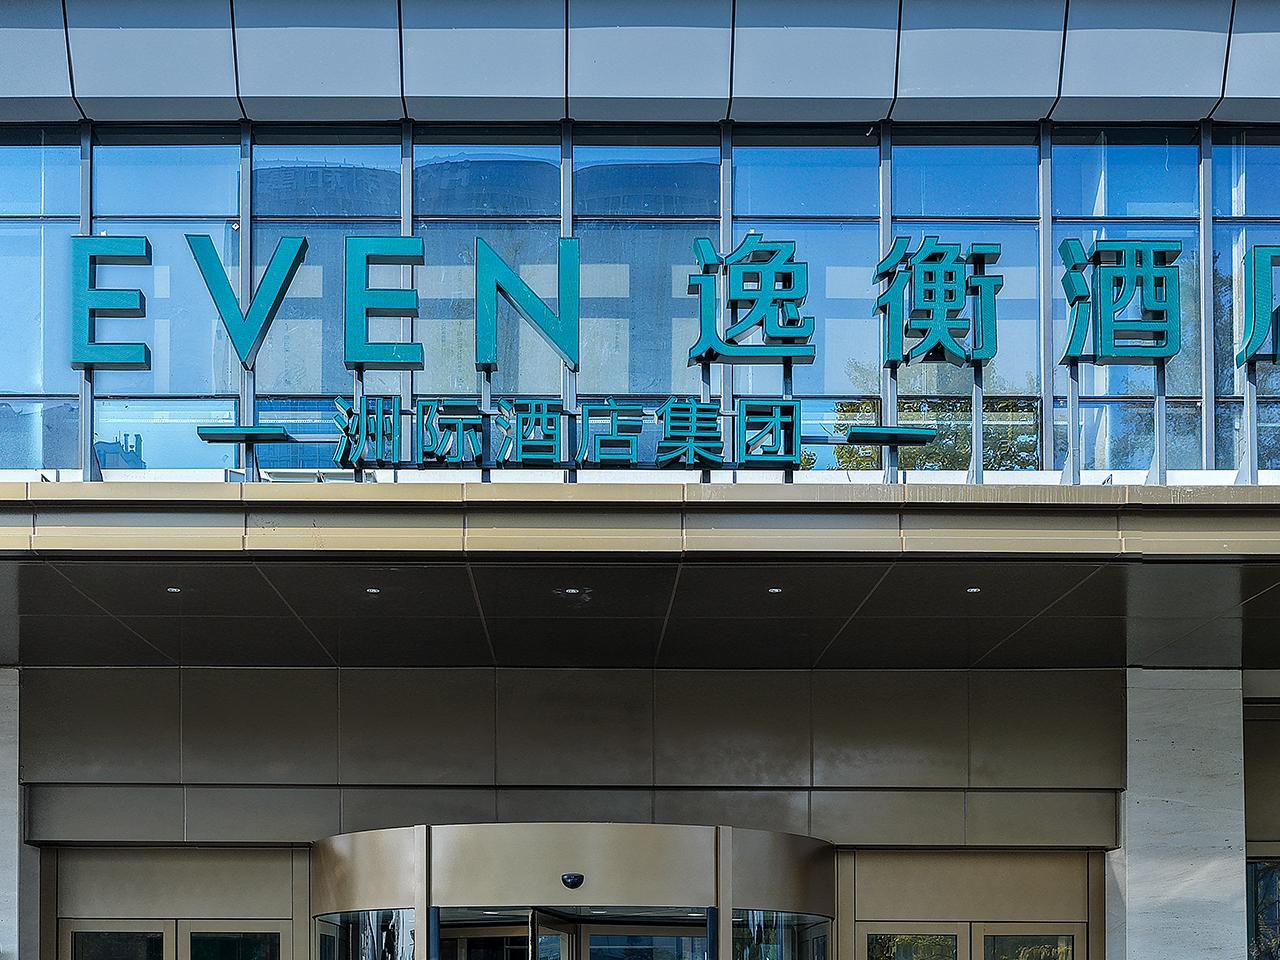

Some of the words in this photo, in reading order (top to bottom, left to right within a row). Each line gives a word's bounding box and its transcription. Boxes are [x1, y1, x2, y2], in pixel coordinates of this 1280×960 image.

[70, 234, 581, 372] EVEN
[334, 395, 802, 470] 洲际酒店集团
